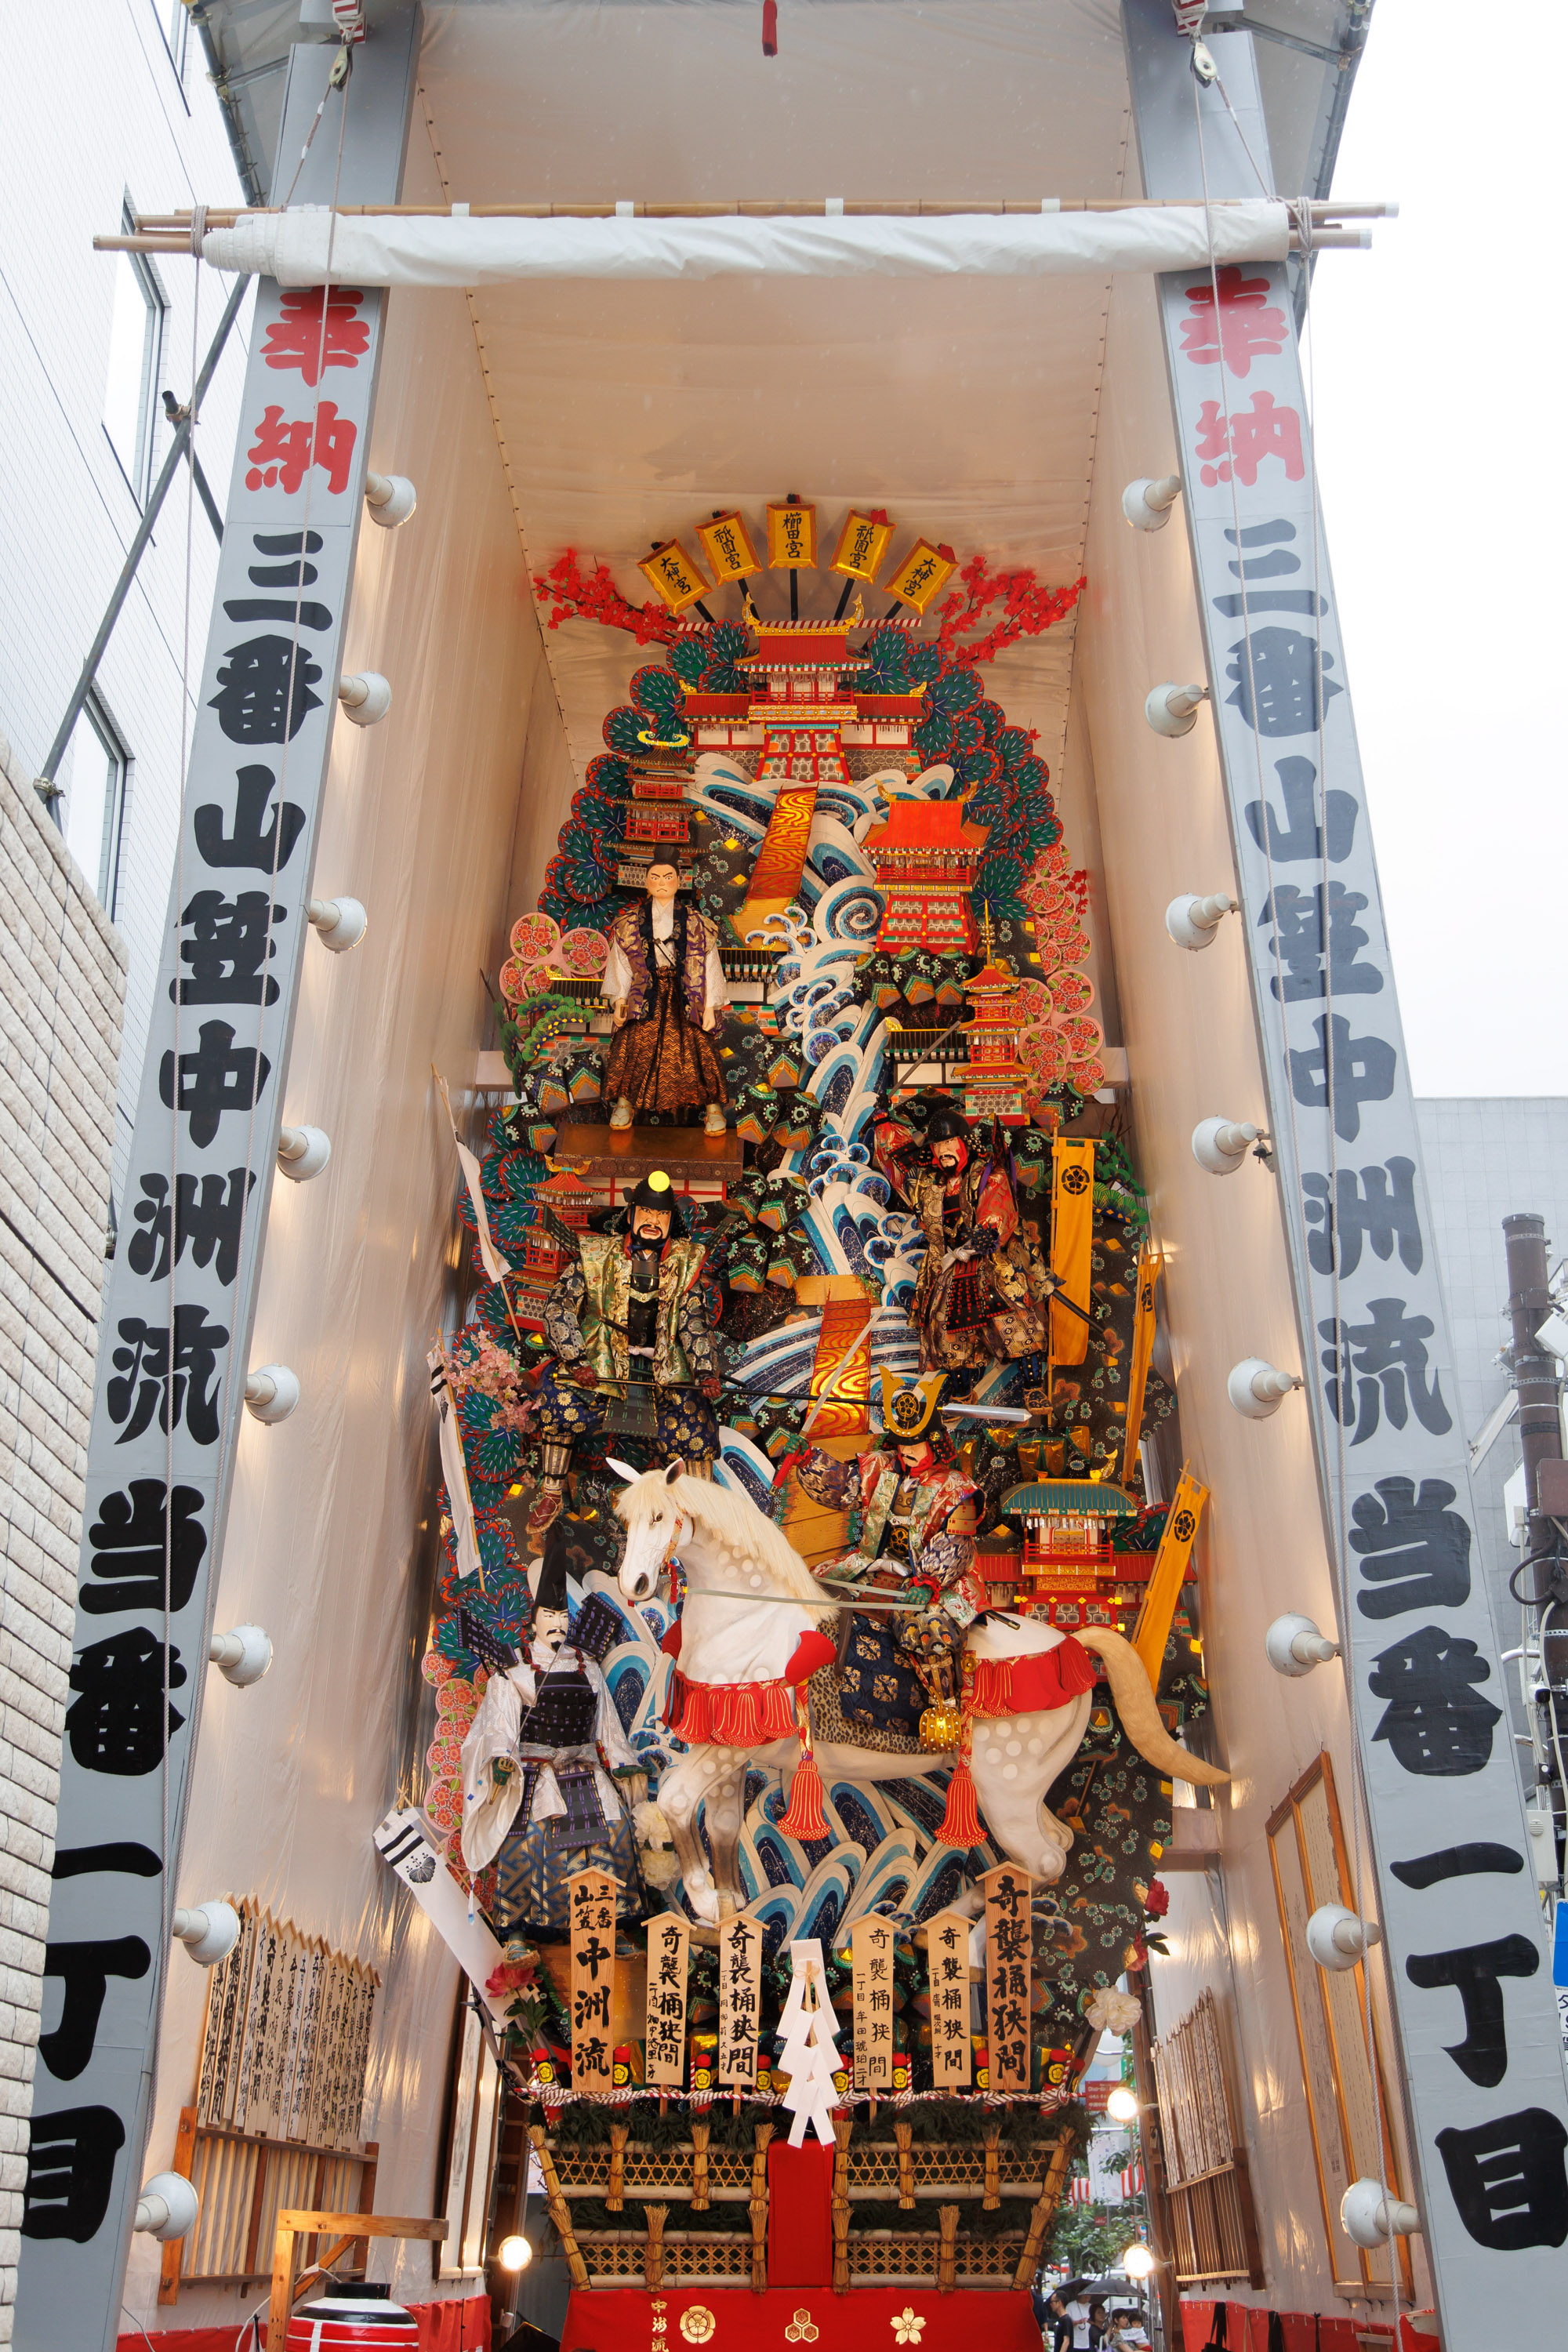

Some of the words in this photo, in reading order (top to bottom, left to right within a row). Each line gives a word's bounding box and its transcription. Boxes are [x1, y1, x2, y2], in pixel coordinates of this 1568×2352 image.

[245, 285, 369, 495] 奉納
[1179, 267, 1305, 487] 奉納
[660, 557, 691, 595] 大神宮
[782, 512, 803, 558] 櫛田宮
[903, 557, 936, 597] 大神宮
[658, 1926, 683, 2067] 奇襲桶狭間
[869, 1928, 891, 2078] 奇襲桶狭間
[938, 1926, 968, 2071] 奇襲桶狭間
[651, 2299, 670, 2352] 中洲流
